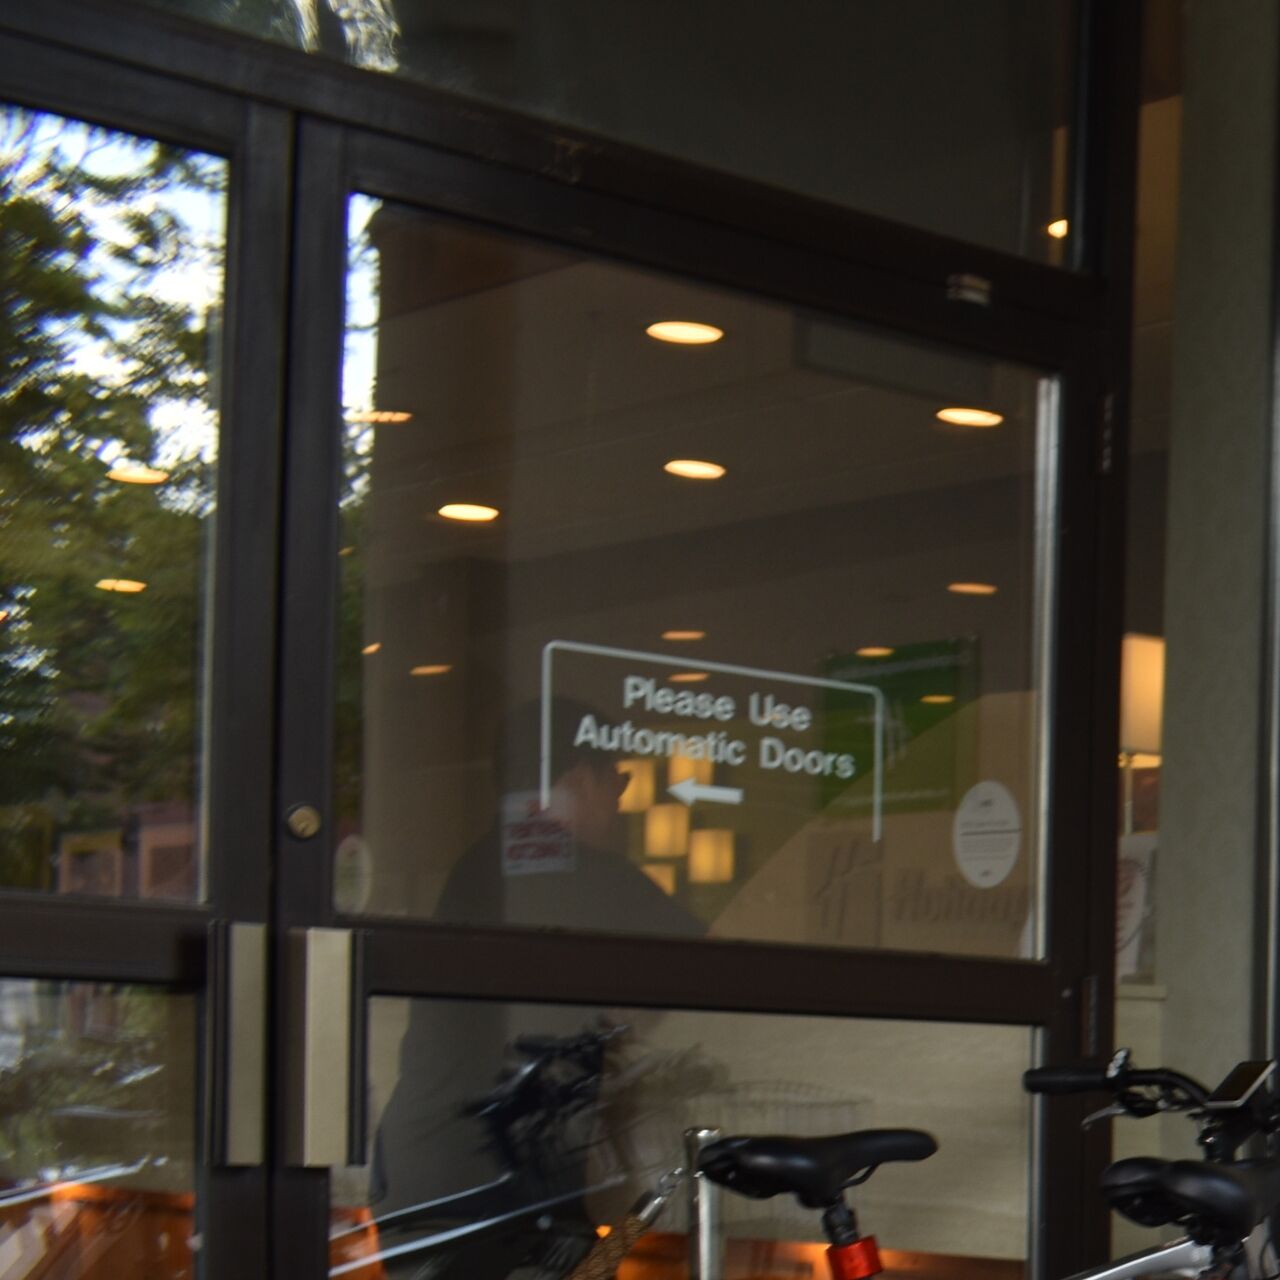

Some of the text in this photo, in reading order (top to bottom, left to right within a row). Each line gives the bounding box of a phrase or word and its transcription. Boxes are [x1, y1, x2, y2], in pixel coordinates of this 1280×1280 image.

[622, 675, 812, 731] Please Use
[574, 714, 856, 778] Automatic Doors
